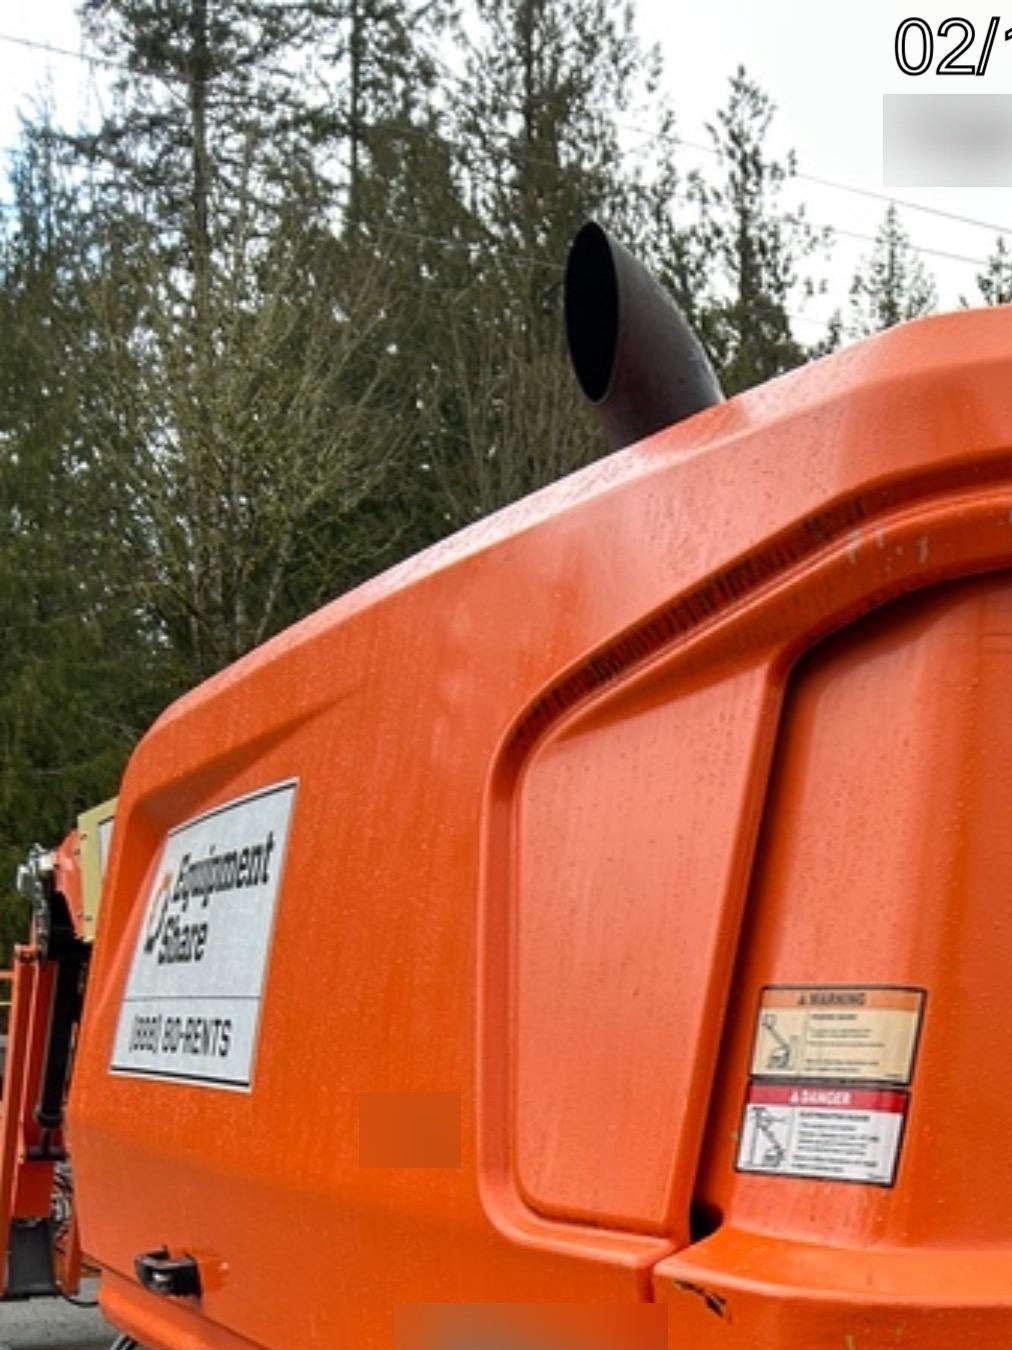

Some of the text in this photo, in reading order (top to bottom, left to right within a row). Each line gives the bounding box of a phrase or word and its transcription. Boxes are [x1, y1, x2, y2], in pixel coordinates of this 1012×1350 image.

[172, 830, 275, 912] Equipment
[158, 916, 208, 965] Share
[162, 1015, 232, 1057] 80-RENTS
